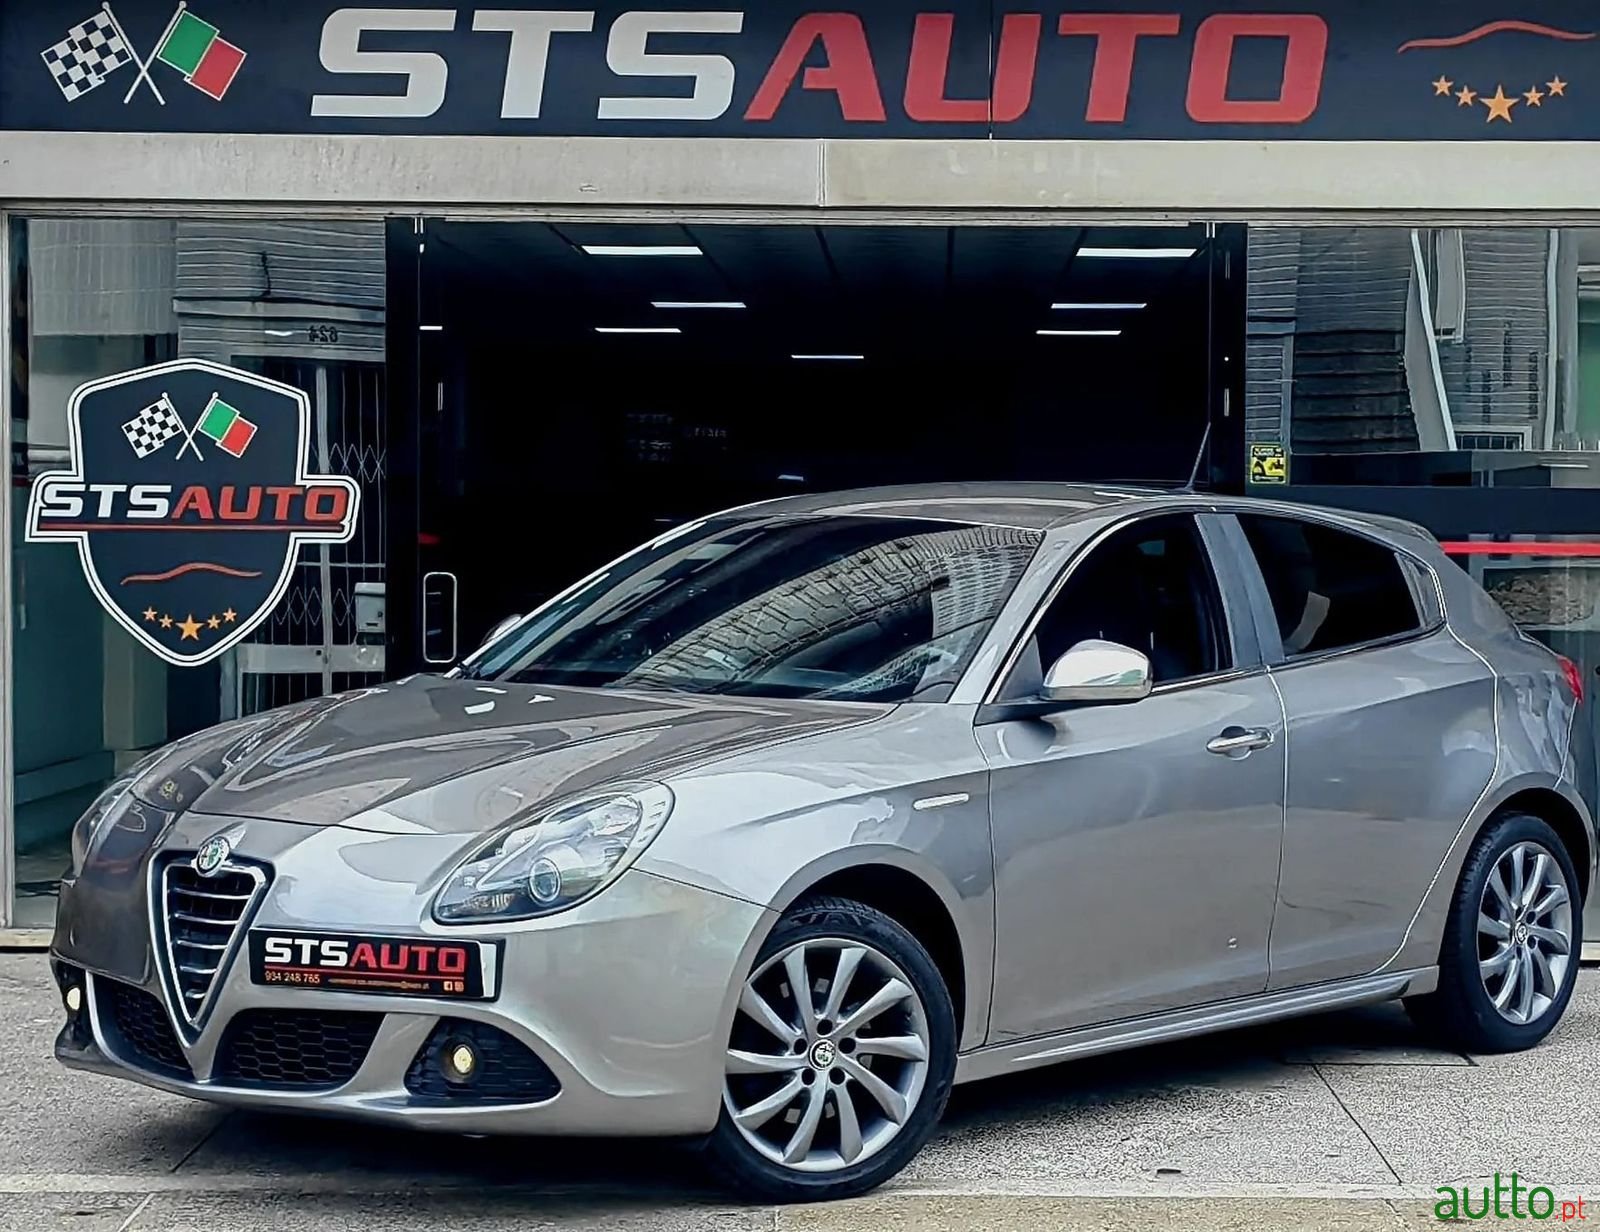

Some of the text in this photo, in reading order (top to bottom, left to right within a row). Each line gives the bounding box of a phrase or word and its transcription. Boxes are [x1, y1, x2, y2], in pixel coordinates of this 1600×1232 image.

[310, 7, 1328, 124] STSAUTO
[41, 484, 349, 522] STSAUTO
[264, 937, 466, 973] STSAUTO
[264, 970, 282, 982] 934
